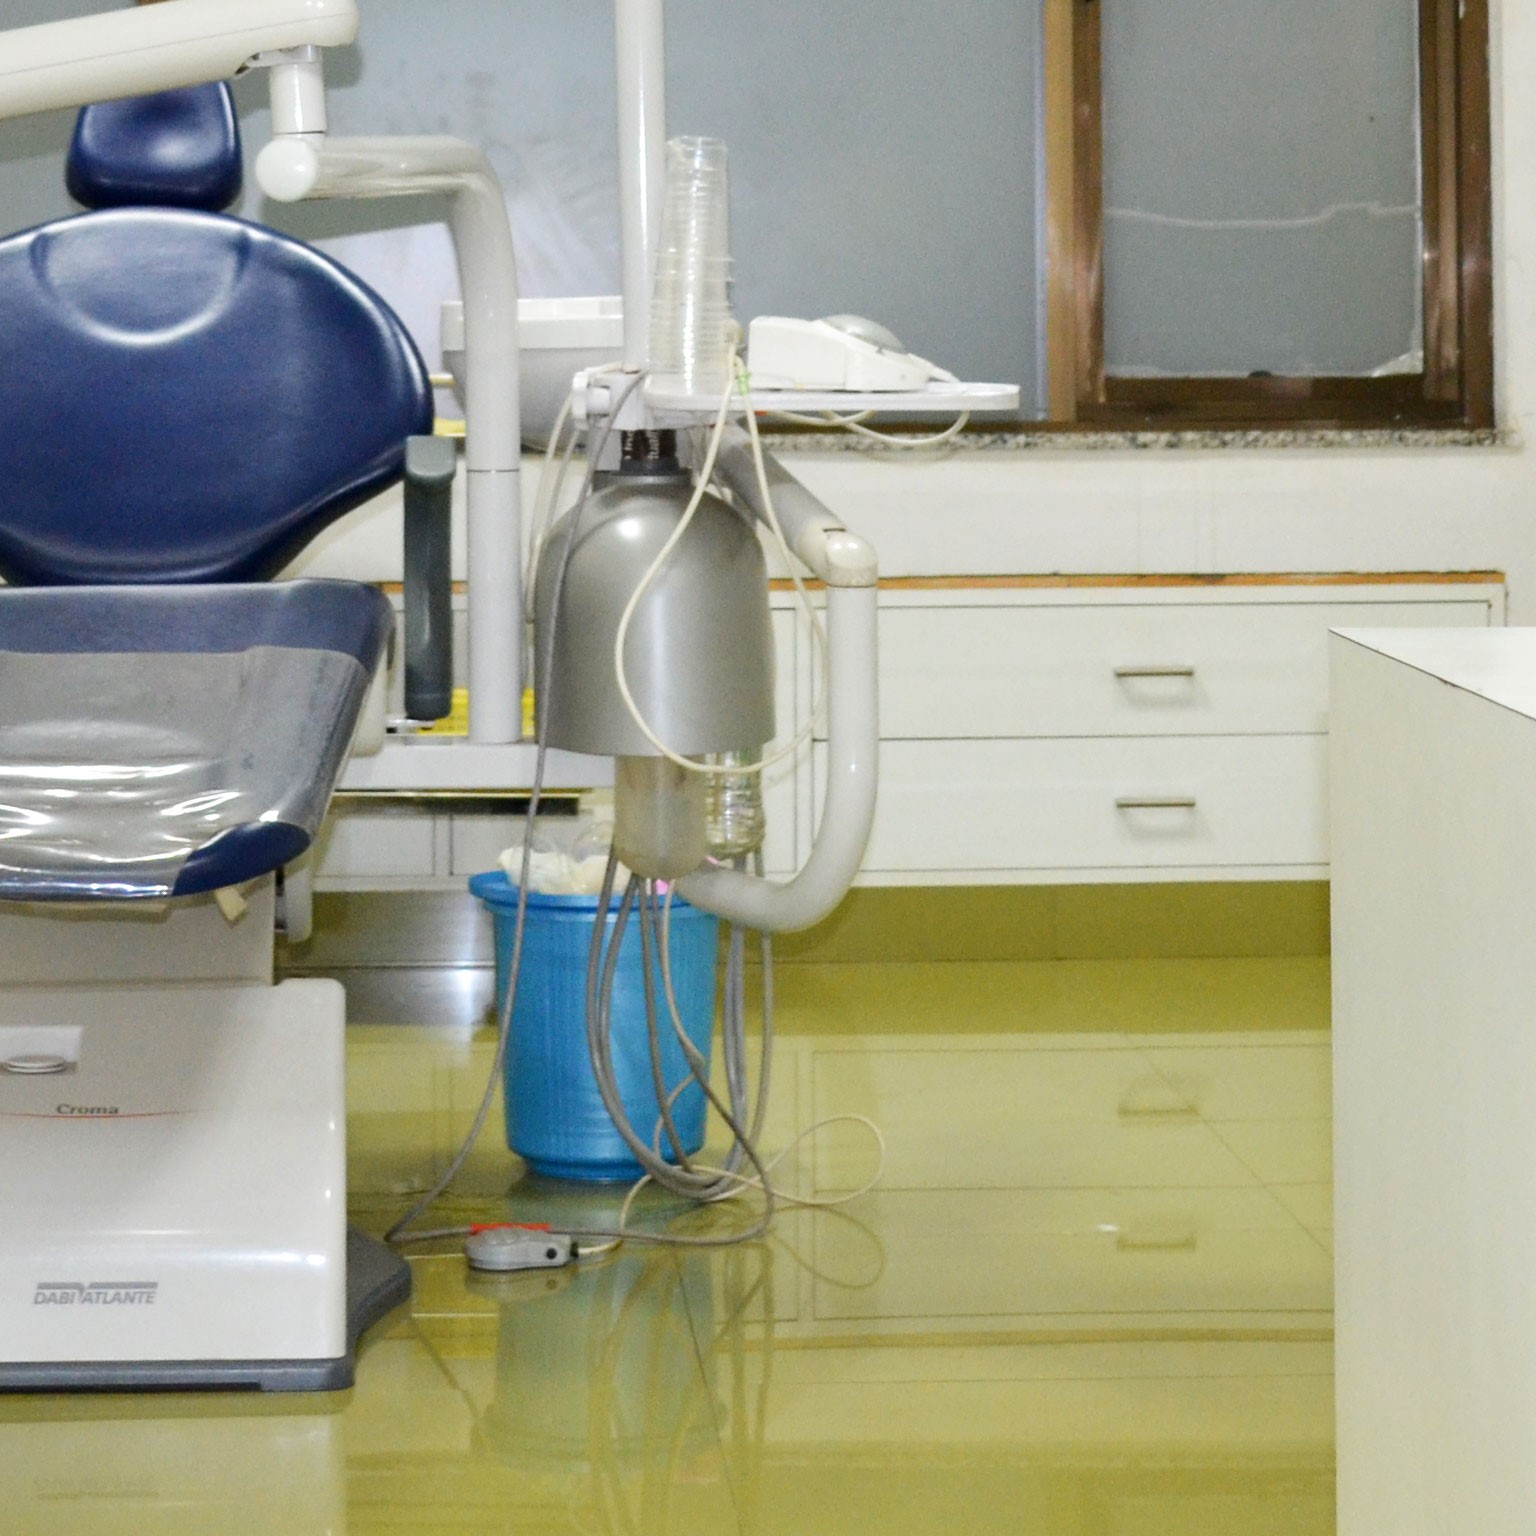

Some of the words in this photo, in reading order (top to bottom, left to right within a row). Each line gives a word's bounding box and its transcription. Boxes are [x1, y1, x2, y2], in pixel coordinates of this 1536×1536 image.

[56, 1104, 119, 1115] Croma
[34, 1291, 76, 1304] DABI
[82, 1290, 157, 1305] ATLANTE
